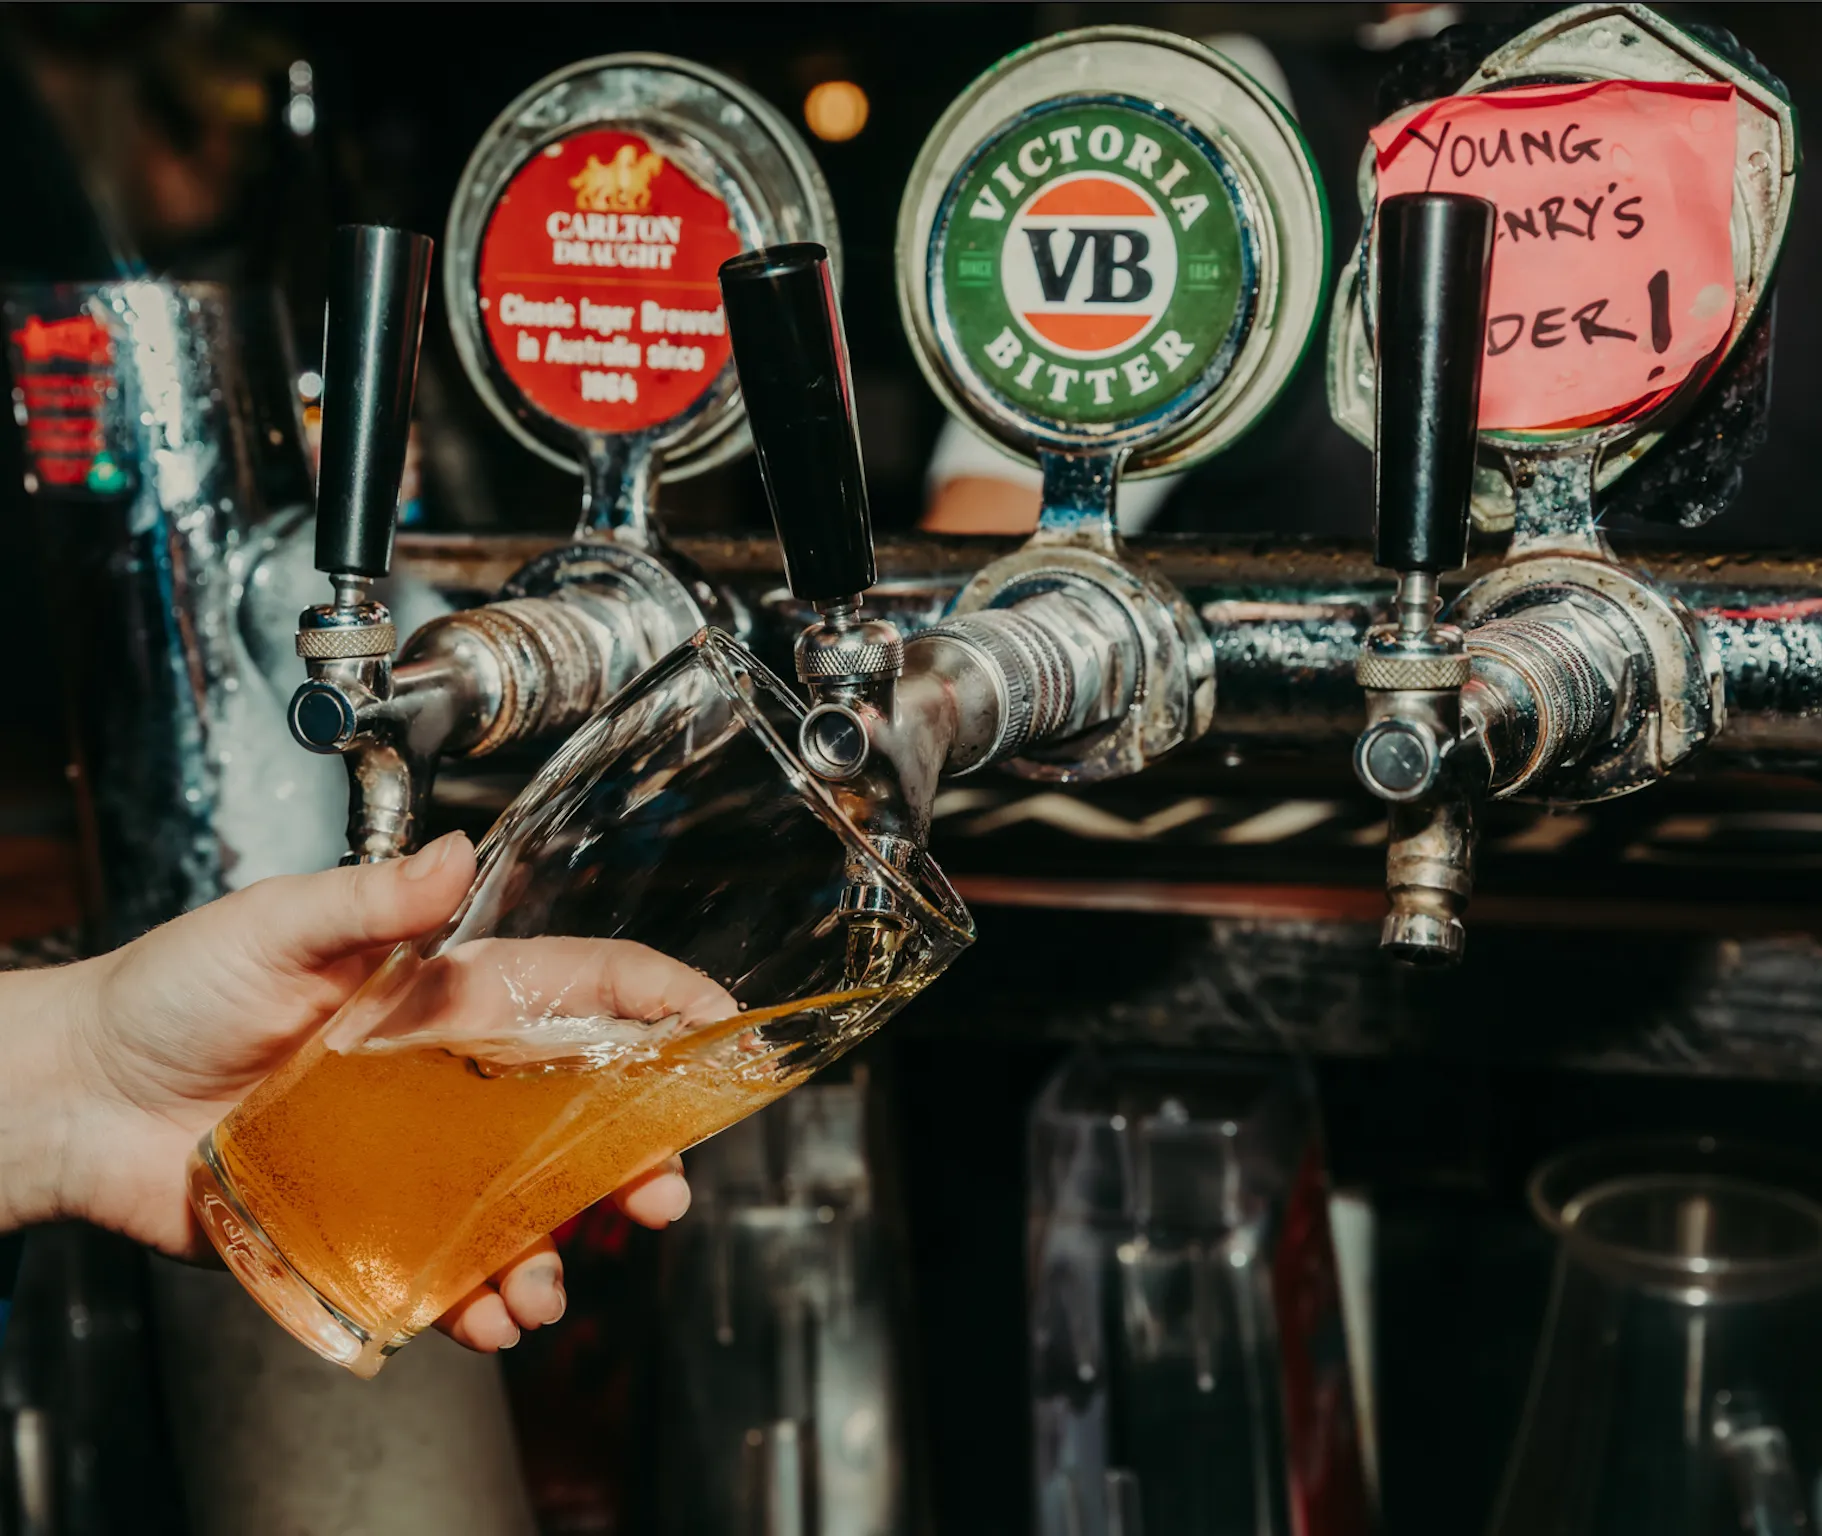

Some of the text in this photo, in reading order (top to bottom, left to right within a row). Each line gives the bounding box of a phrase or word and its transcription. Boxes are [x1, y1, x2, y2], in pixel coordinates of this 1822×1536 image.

[969, 125, 1209, 231] VICTORIA
[1407, 121, 1604, 192] YOUNG
[546, 211, 682, 244] CARLTON
[1497, 182, 1644, 242] NRY'S
[553, 239, 676, 269] DRAUGHT
[1022, 229, 1153, 303] VB
[500, 293, 575, 329] Classic
[1487, 270, 1672, 381] DER!
[517, 330, 705, 372] in Australia since
[984, 326, 1195, 405] BITTER
